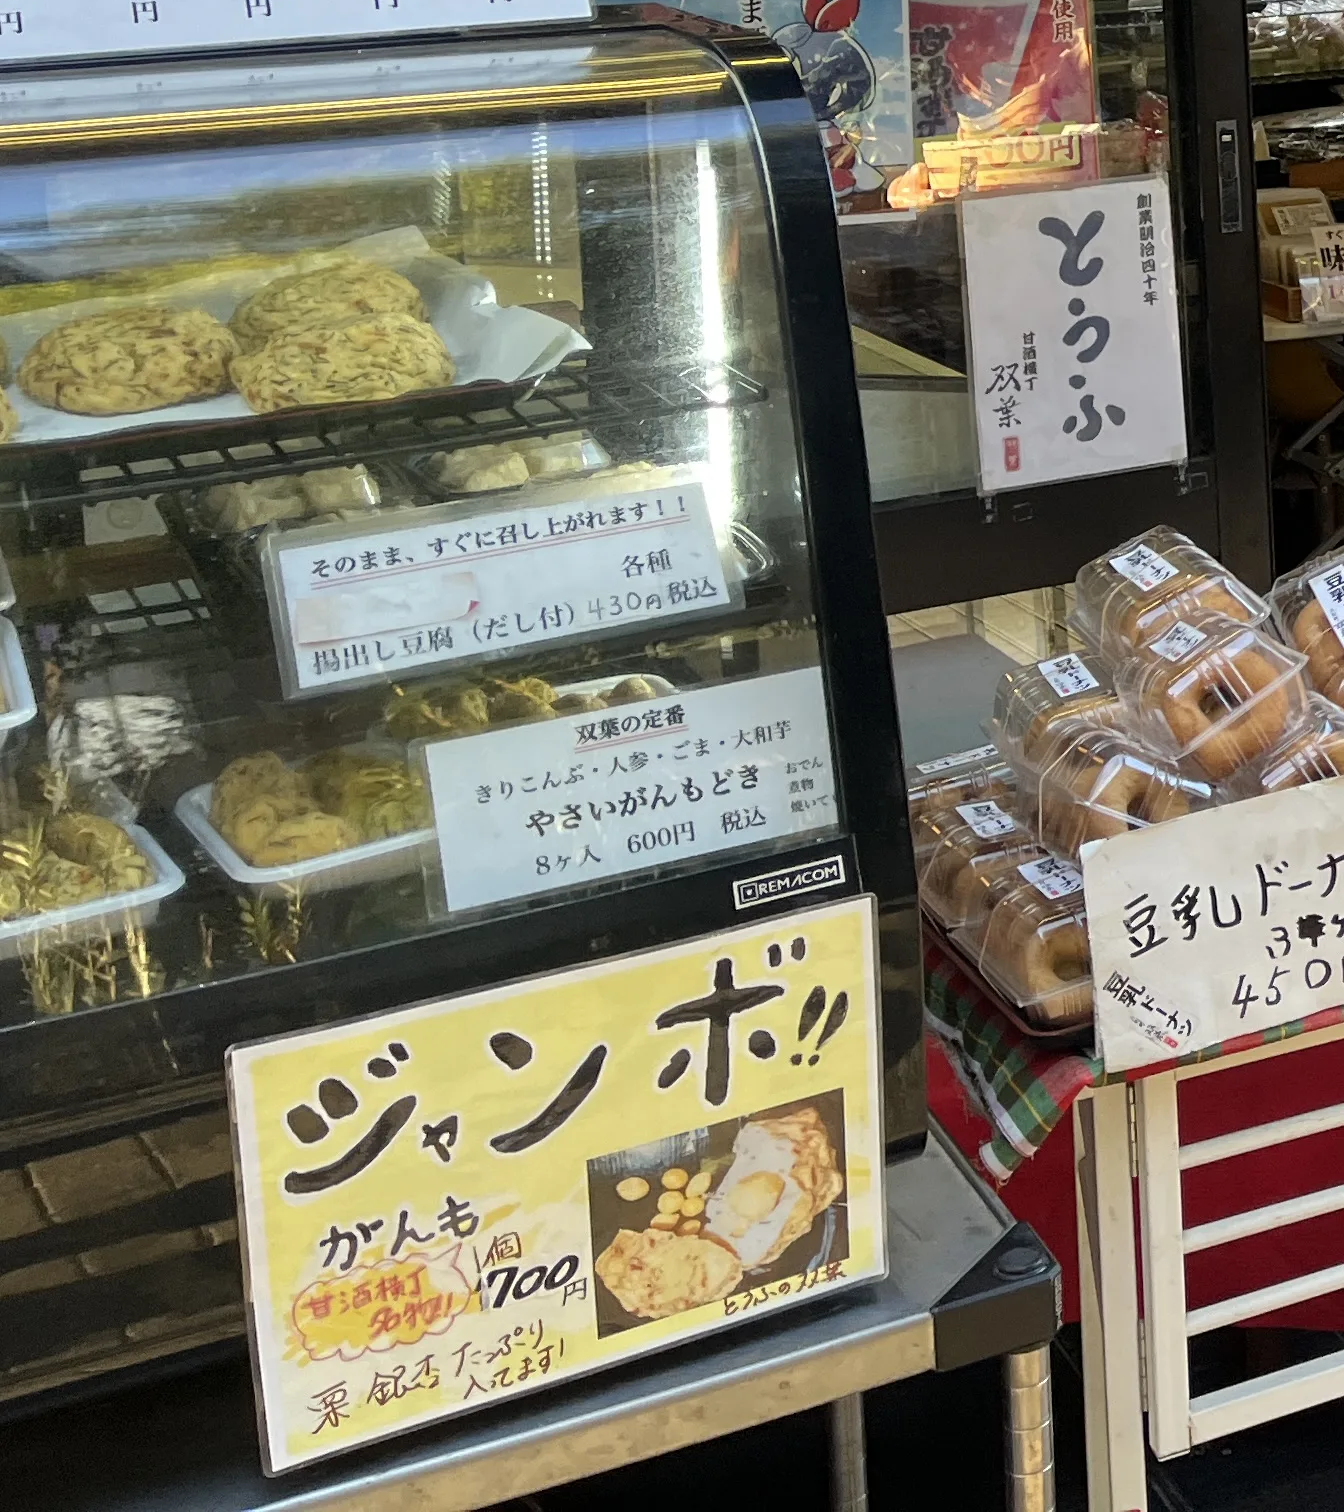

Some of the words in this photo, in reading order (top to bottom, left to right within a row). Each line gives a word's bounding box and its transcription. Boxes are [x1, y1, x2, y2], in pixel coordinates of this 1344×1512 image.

[1136, 193, 1160, 307] 創業明治四十年
[1038, 210, 1126, 442] とうふ
[984, 362, 1022, 429] 双葉
[620, 547, 674, 578] 各種
[666, 574, 719, 607] 税込
[575, 703, 686, 747] 双葉の定番
[524, 764, 761, 838] やさいがんもどき
[626, 821, 697, 856] 600円
[720, 806, 767, 835] 税込
[757, 861, 840, 898] REMACOM
[1102, 970, 1195, 1038] 豆乳ドーナツ
[319, 1196, 480, 1272] がんも
[485, 1254, 589, 1312] 700円
[307, 1381, 350, 1436] 栗
